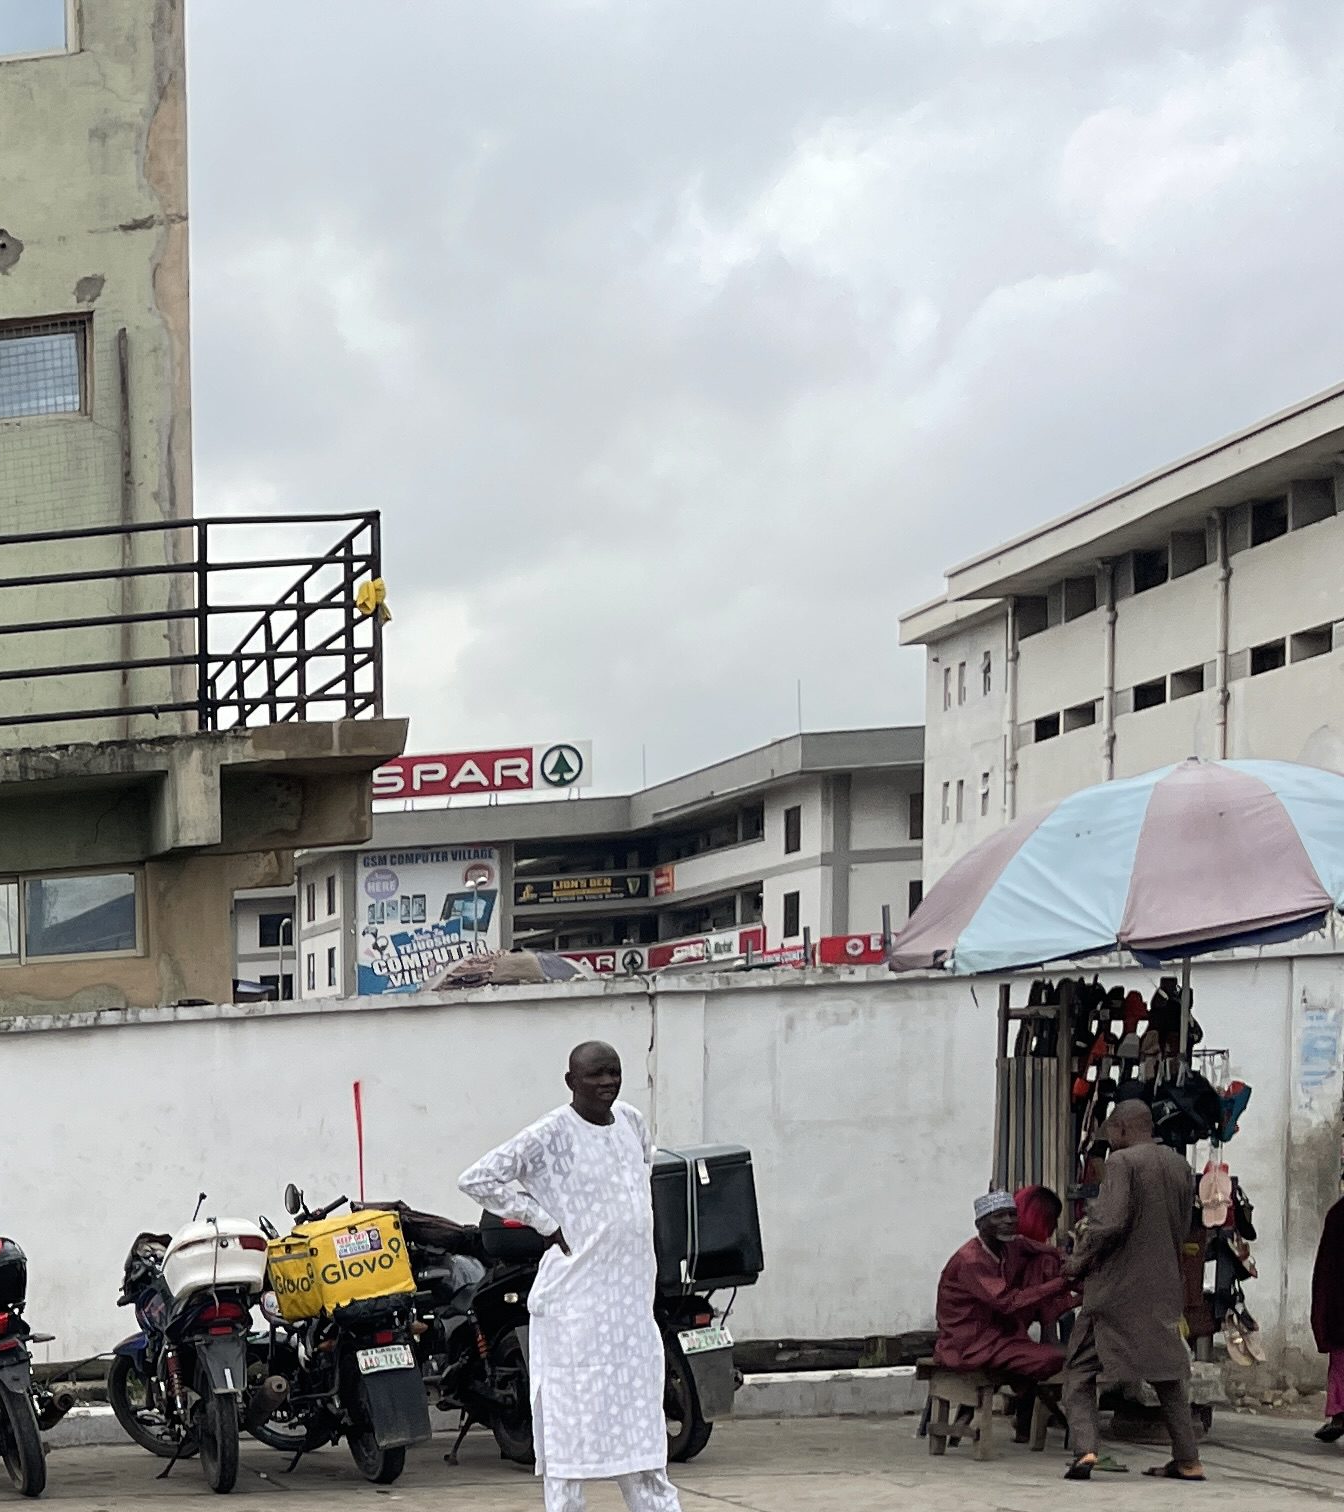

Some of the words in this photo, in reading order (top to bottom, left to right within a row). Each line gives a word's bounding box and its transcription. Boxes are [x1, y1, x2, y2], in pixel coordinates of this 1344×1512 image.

[372, 757, 529, 795] SPAR
[363, 855, 388, 868] GSM
[389, 851, 449, 866] COMPUTER
[451, 848, 494, 861] VILLAGE
[321, 1254, 394, 1285] Glovo
